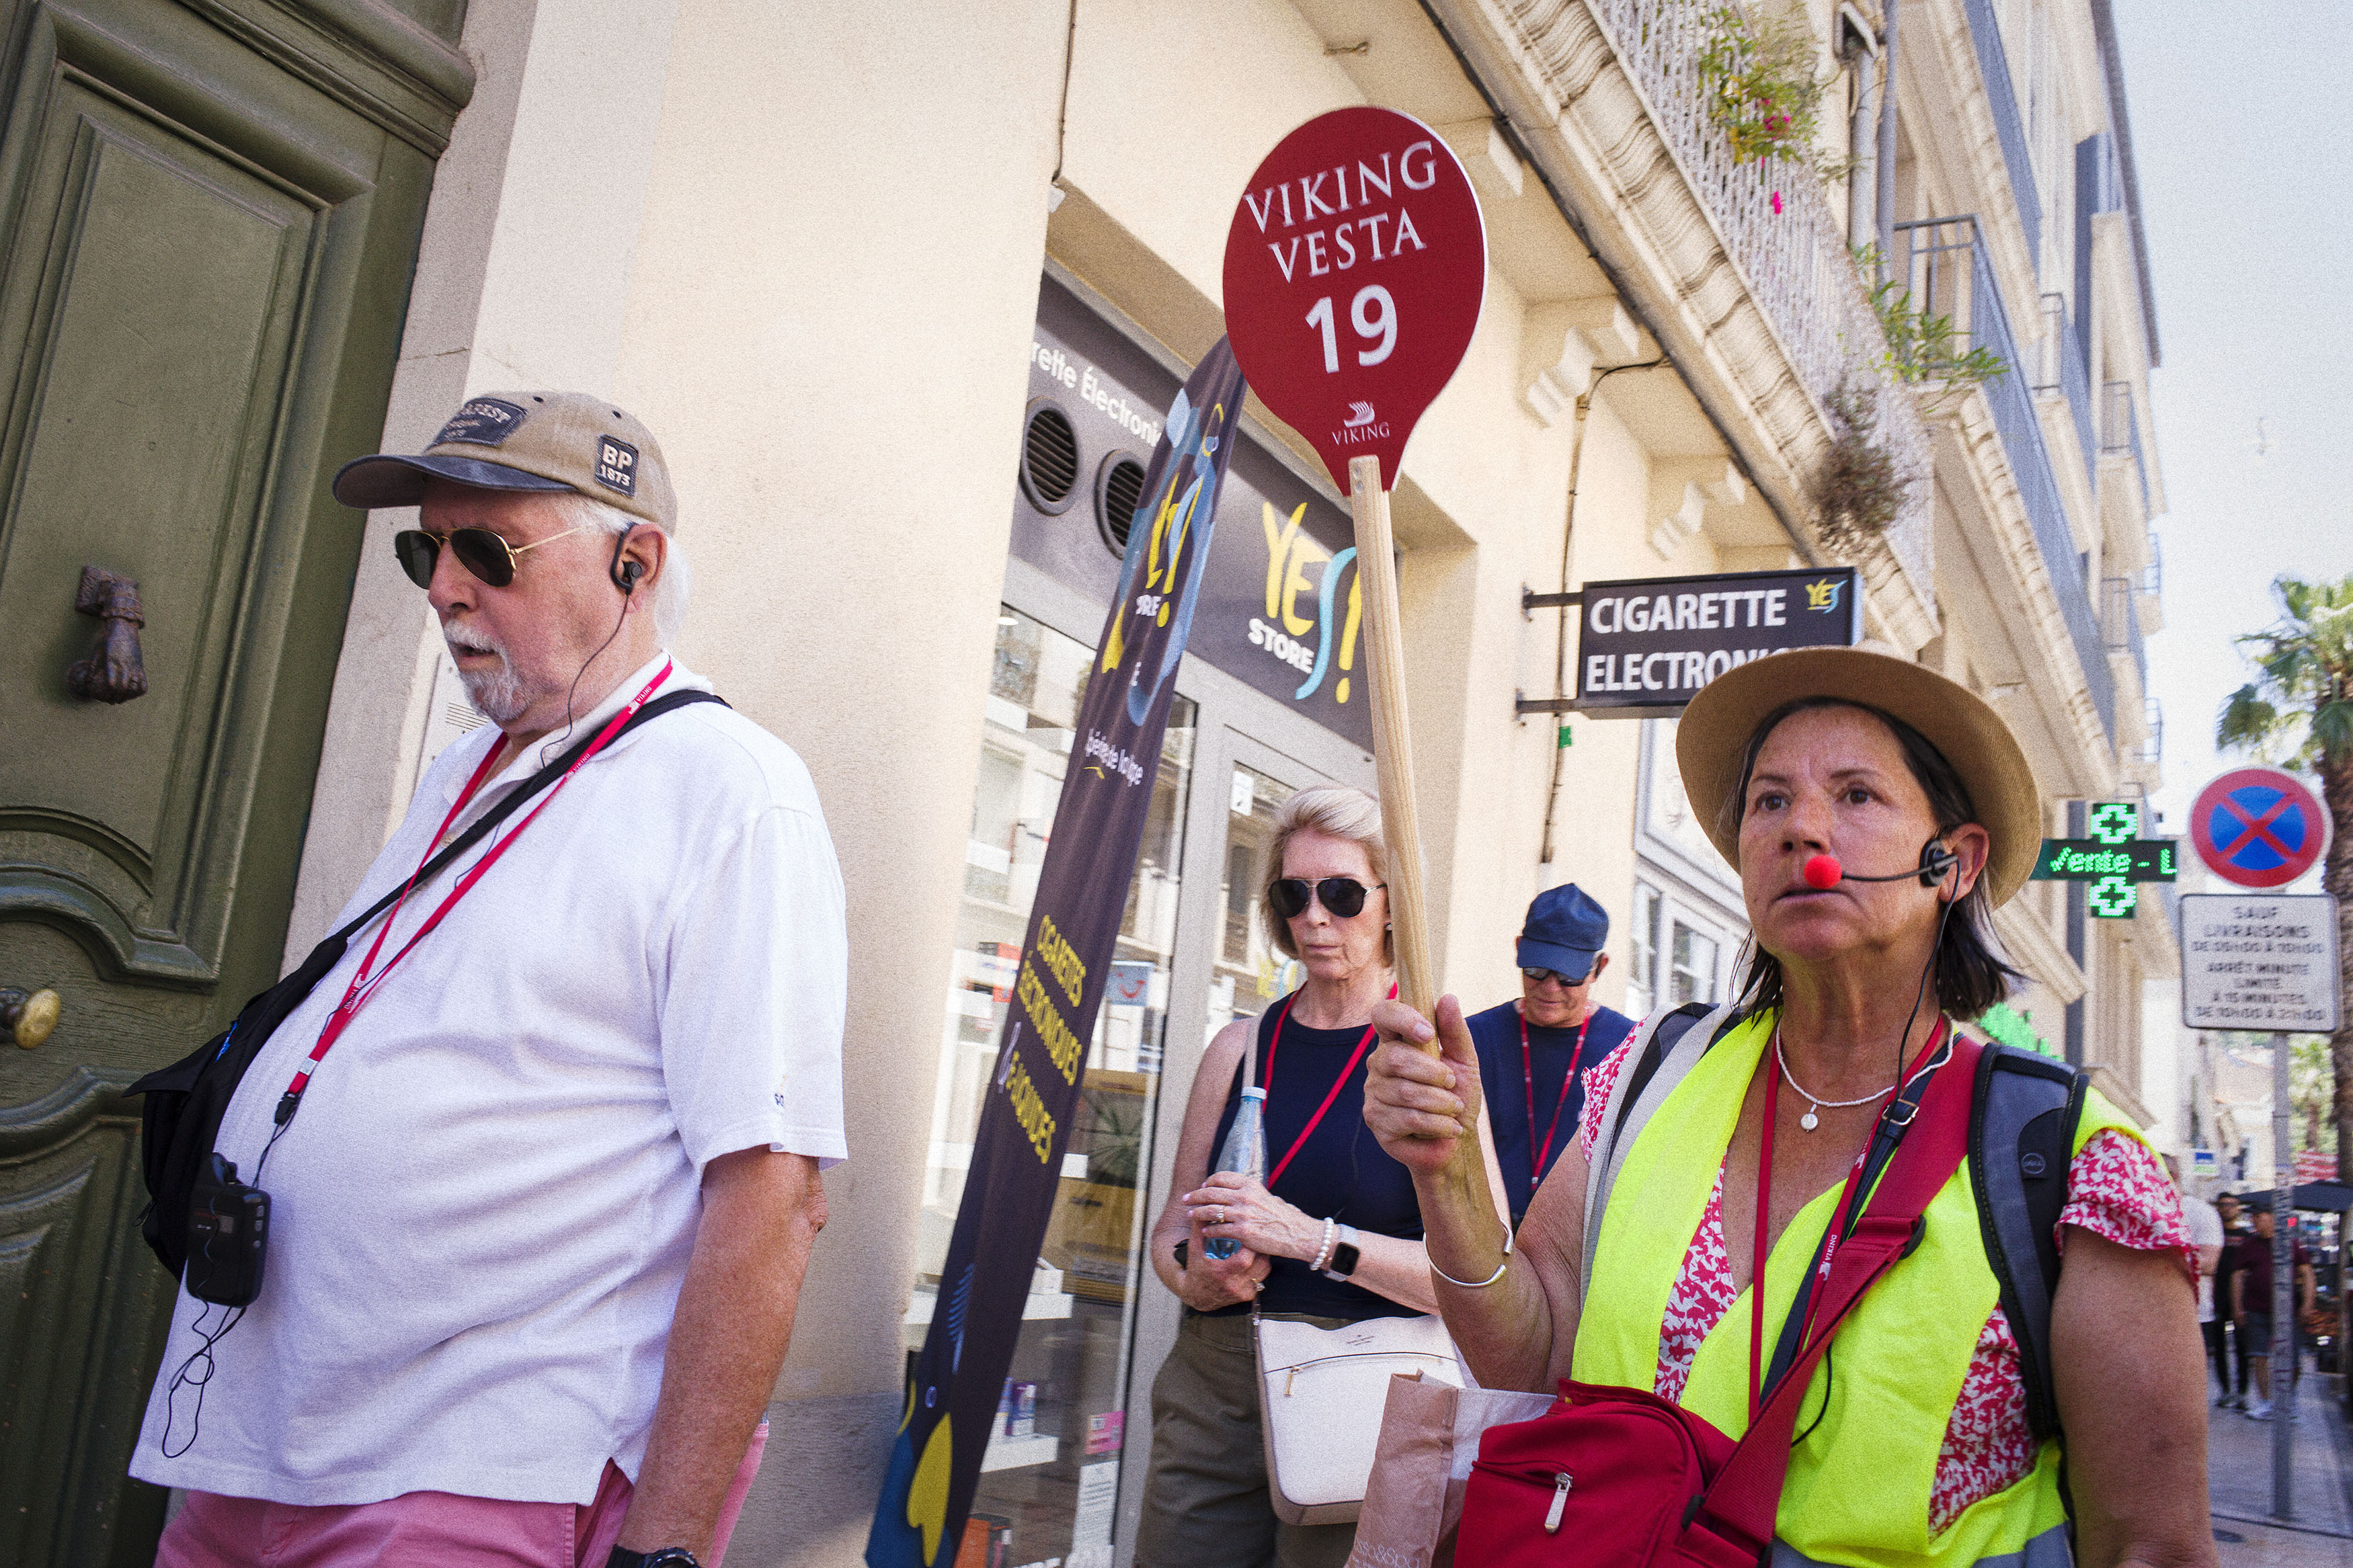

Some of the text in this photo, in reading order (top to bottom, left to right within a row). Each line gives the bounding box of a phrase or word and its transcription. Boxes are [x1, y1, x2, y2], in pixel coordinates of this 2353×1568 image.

[1242, 140, 1437, 235] VIKING
[1267, 207, 1427, 284] VESTA
[1305, 284, 1398, 374] 19
[1031, 341, 1077, 388] rette
[1332, 421, 1390, 445] VIKING
[602, 444, 633, 469] BP
[600, 464, 630, 486] 1873
[1589, 589, 1787, 634] CIGARETTE
[1248, 618, 1314, 674] STORE
[2050, 847, 2132, 873] Vente
[2233, 907, 2280, 919] SAUF
[2204, 925, 2310, 938] LIVRAISONS
[1825, 1234, 1837, 1260] VIKING
